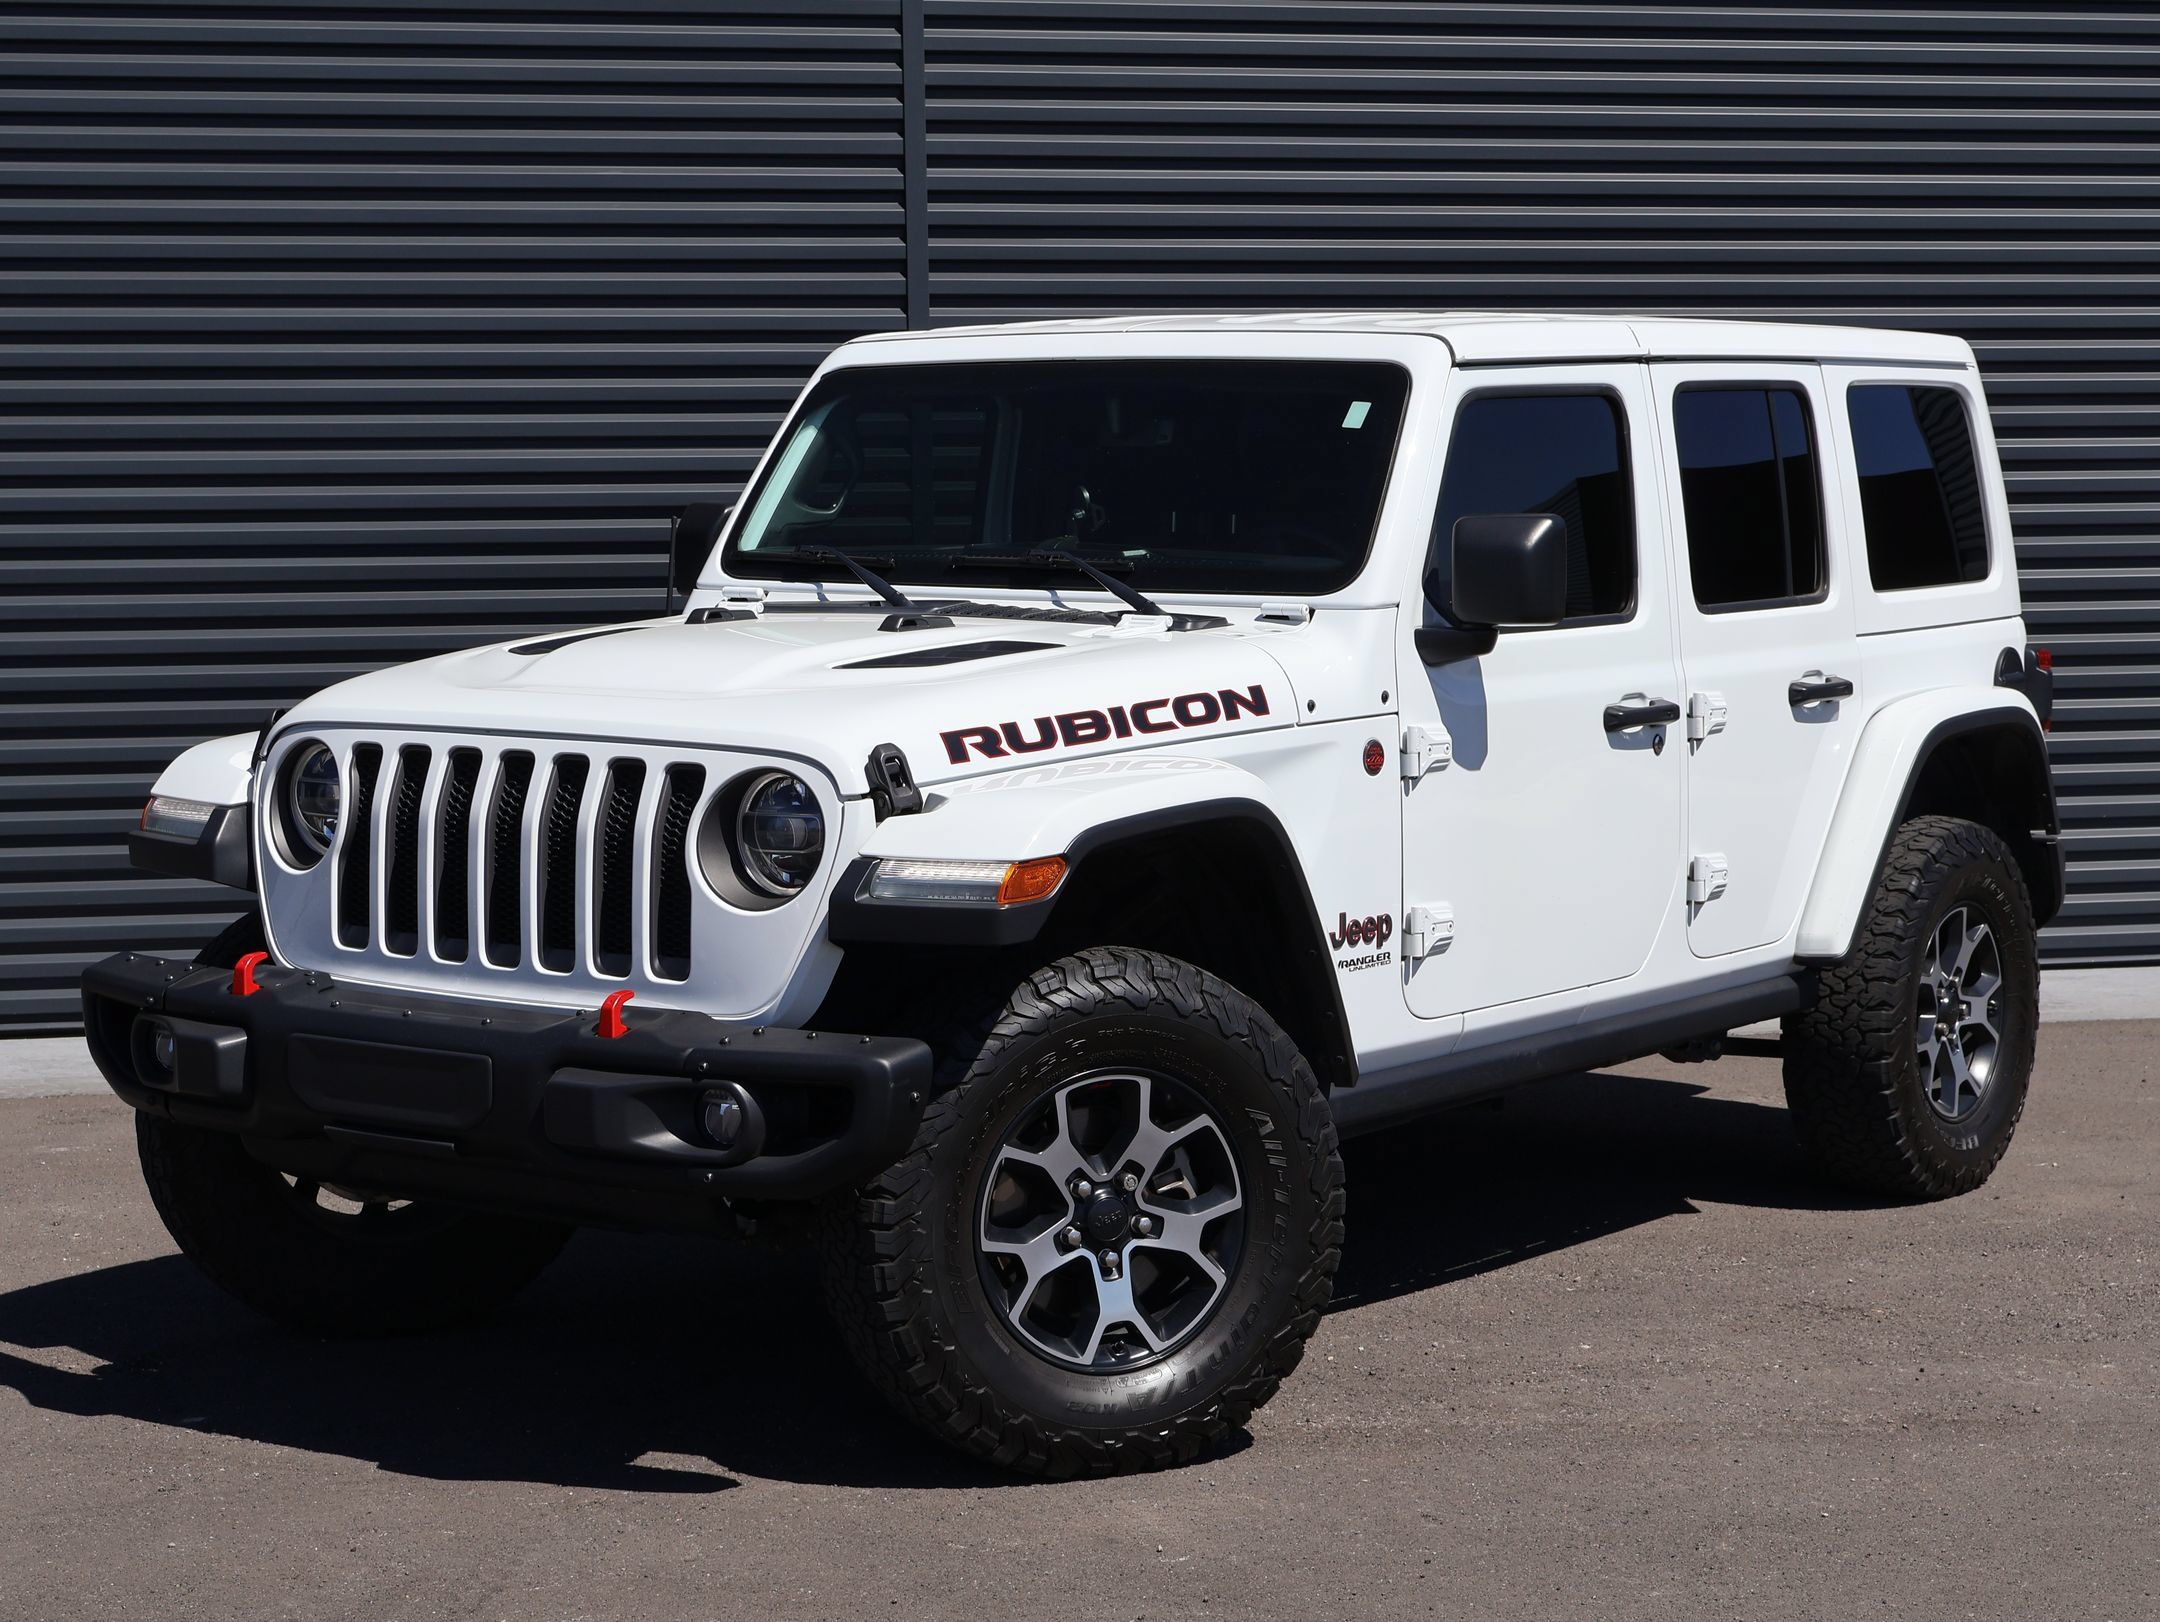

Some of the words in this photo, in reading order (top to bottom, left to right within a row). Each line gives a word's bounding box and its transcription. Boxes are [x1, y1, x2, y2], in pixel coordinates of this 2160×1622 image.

[939, 684, 1271, 765] RUBICON
[1329, 911, 1393, 951] Jeep
[1348, 960, 1391, 972] UNLIMITED
